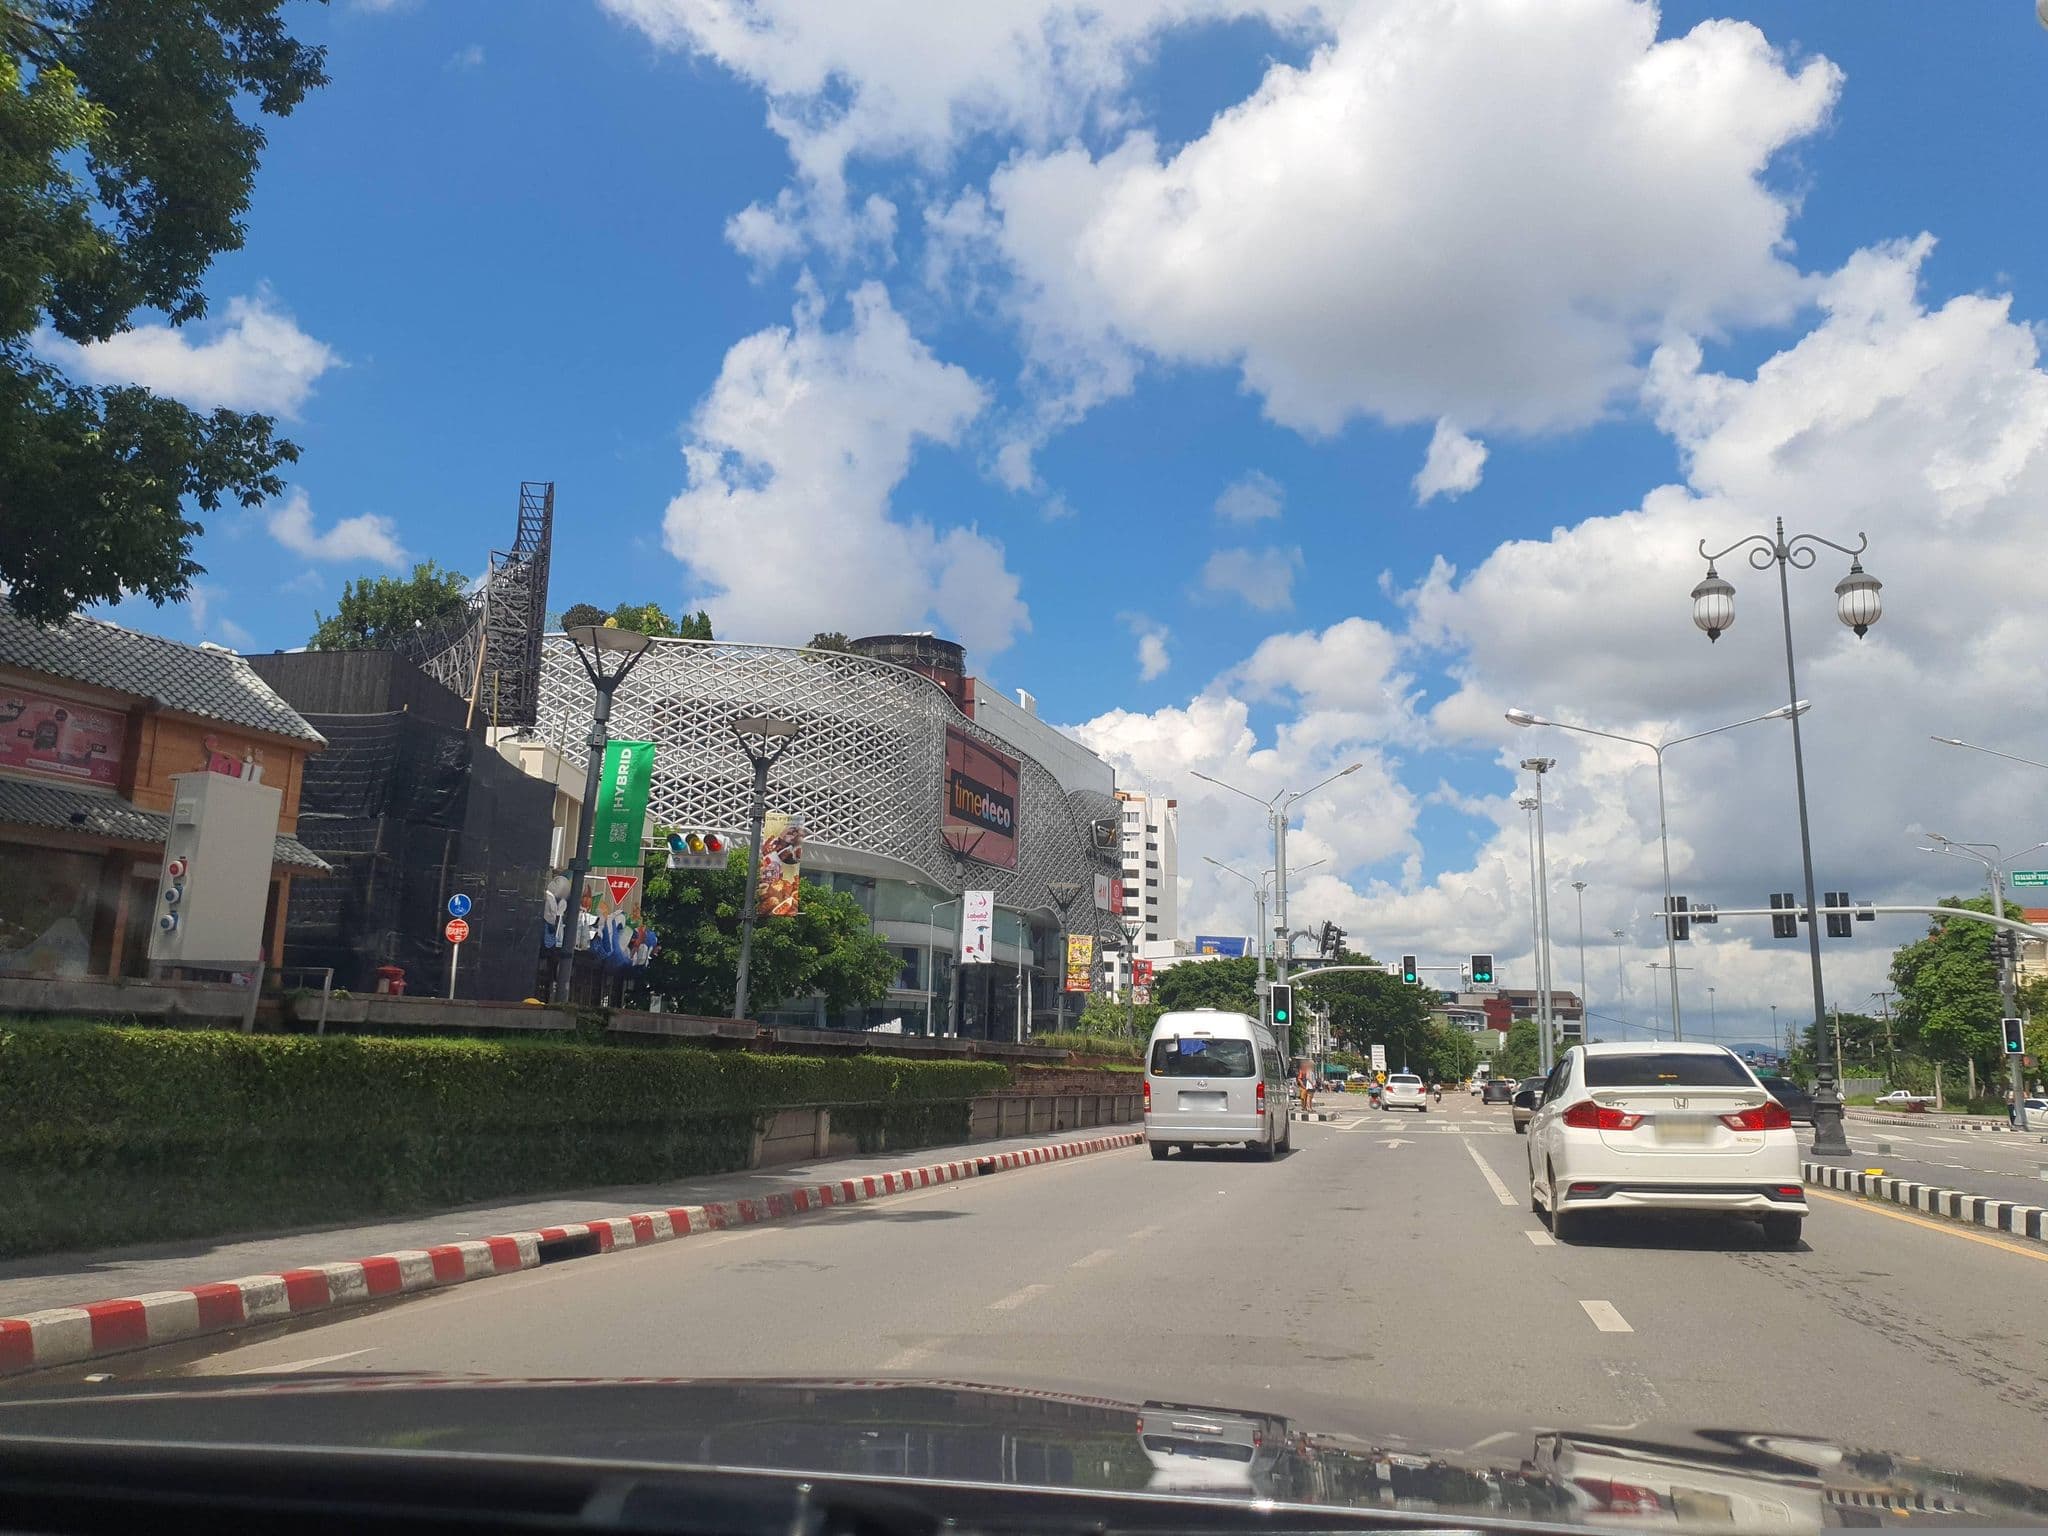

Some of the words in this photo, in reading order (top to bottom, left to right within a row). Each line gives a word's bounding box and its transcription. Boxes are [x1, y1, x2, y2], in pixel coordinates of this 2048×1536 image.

[614, 748, 632, 808] HYBRID
[955, 778, 1011, 828] timedeco
[610, 880, 631, 889] 止まれ
